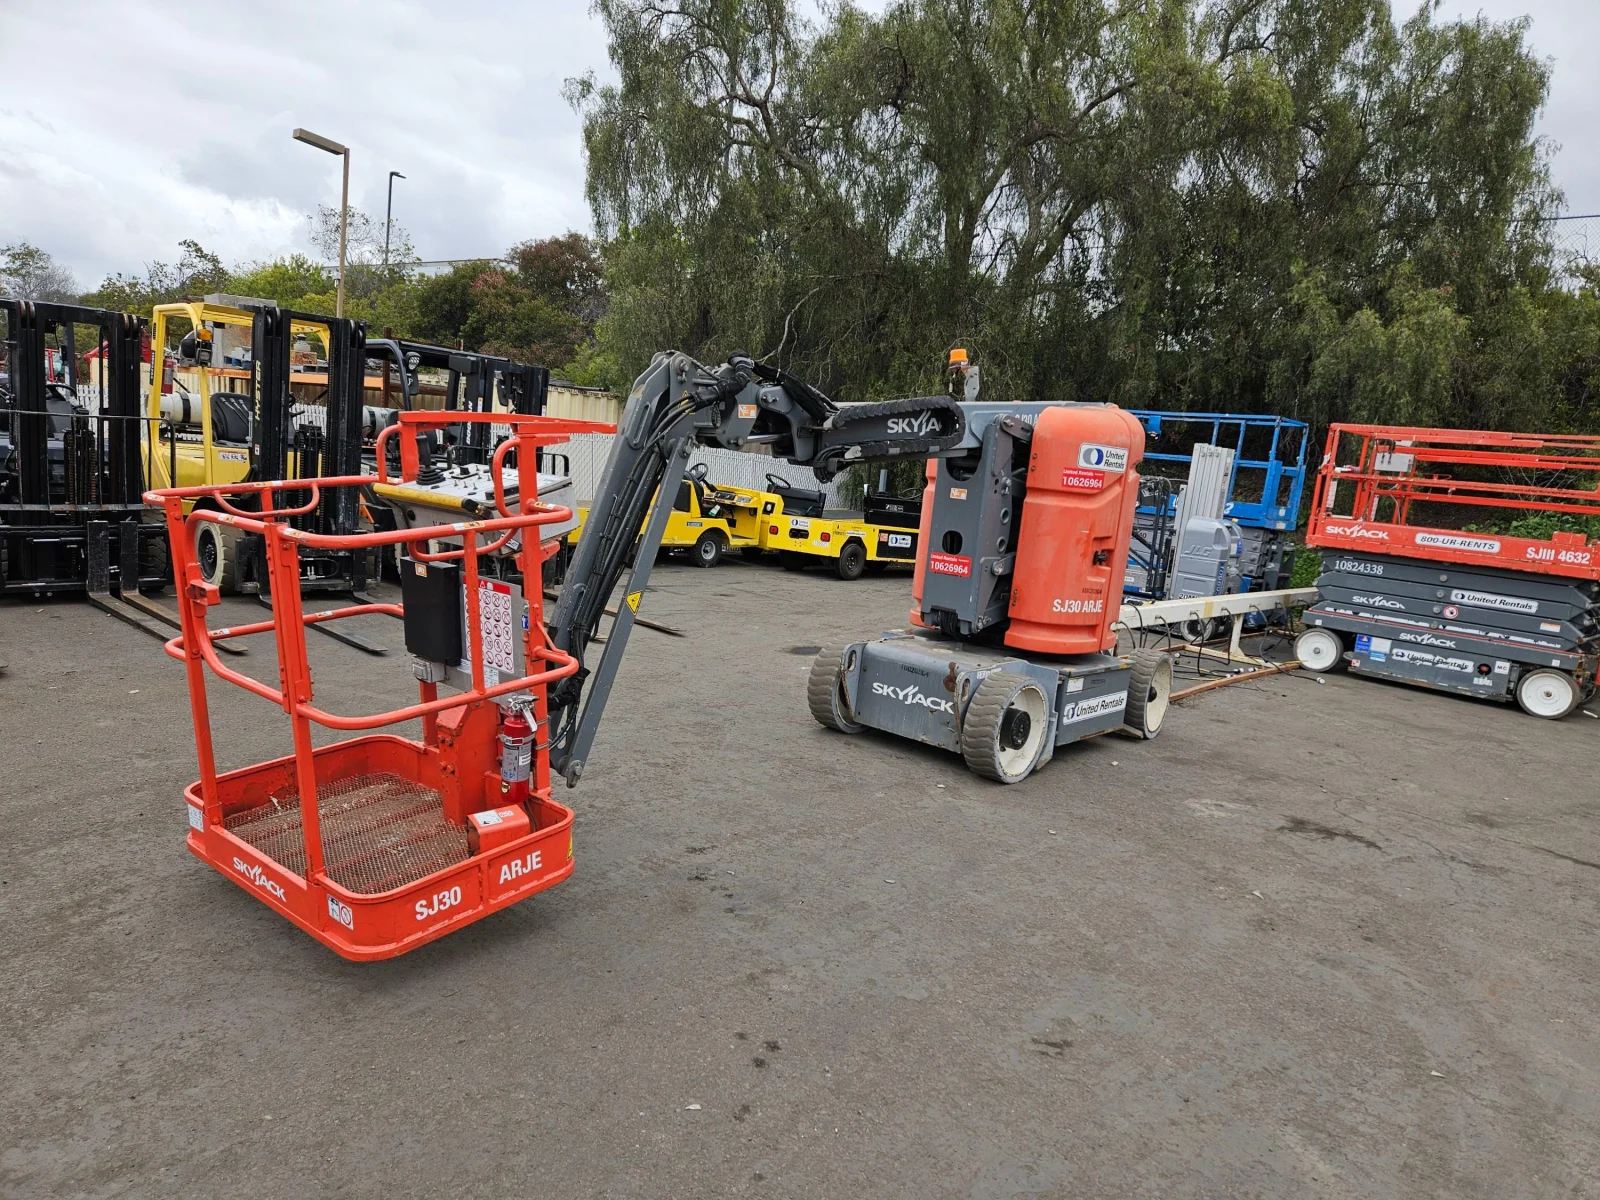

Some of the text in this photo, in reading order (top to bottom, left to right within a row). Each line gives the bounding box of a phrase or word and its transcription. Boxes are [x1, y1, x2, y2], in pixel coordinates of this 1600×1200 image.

[887, 409, 942, 436] SKYJA
[1105, 450, 1125, 461] United
[1104, 459, 1125, 469] Rentals
[1063, 476, 1102, 488] 10626964
[1326, 525, 1389, 540] SKYJACK
[1420, 536, 1495, 550] 800-UR-RENTS
[1557, 550, 1591, 564] 4632
[931, 561, 968, 574] 10626964
[1335, 560, 1383, 575] 10824338
[1053, 599, 1103, 613] SJ30 ARJE
[1467, 594, 1533, 611] United Rentals
[1399, 632, 1456, 648] SKYJACK
[872, 682, 955, 715] SKYJACK
[1076, 696, 1124, 717] United Rentals
[233, 856, 286, 902] SKYJACK
[415, 850, 542, 920] SJ30 ARJE
